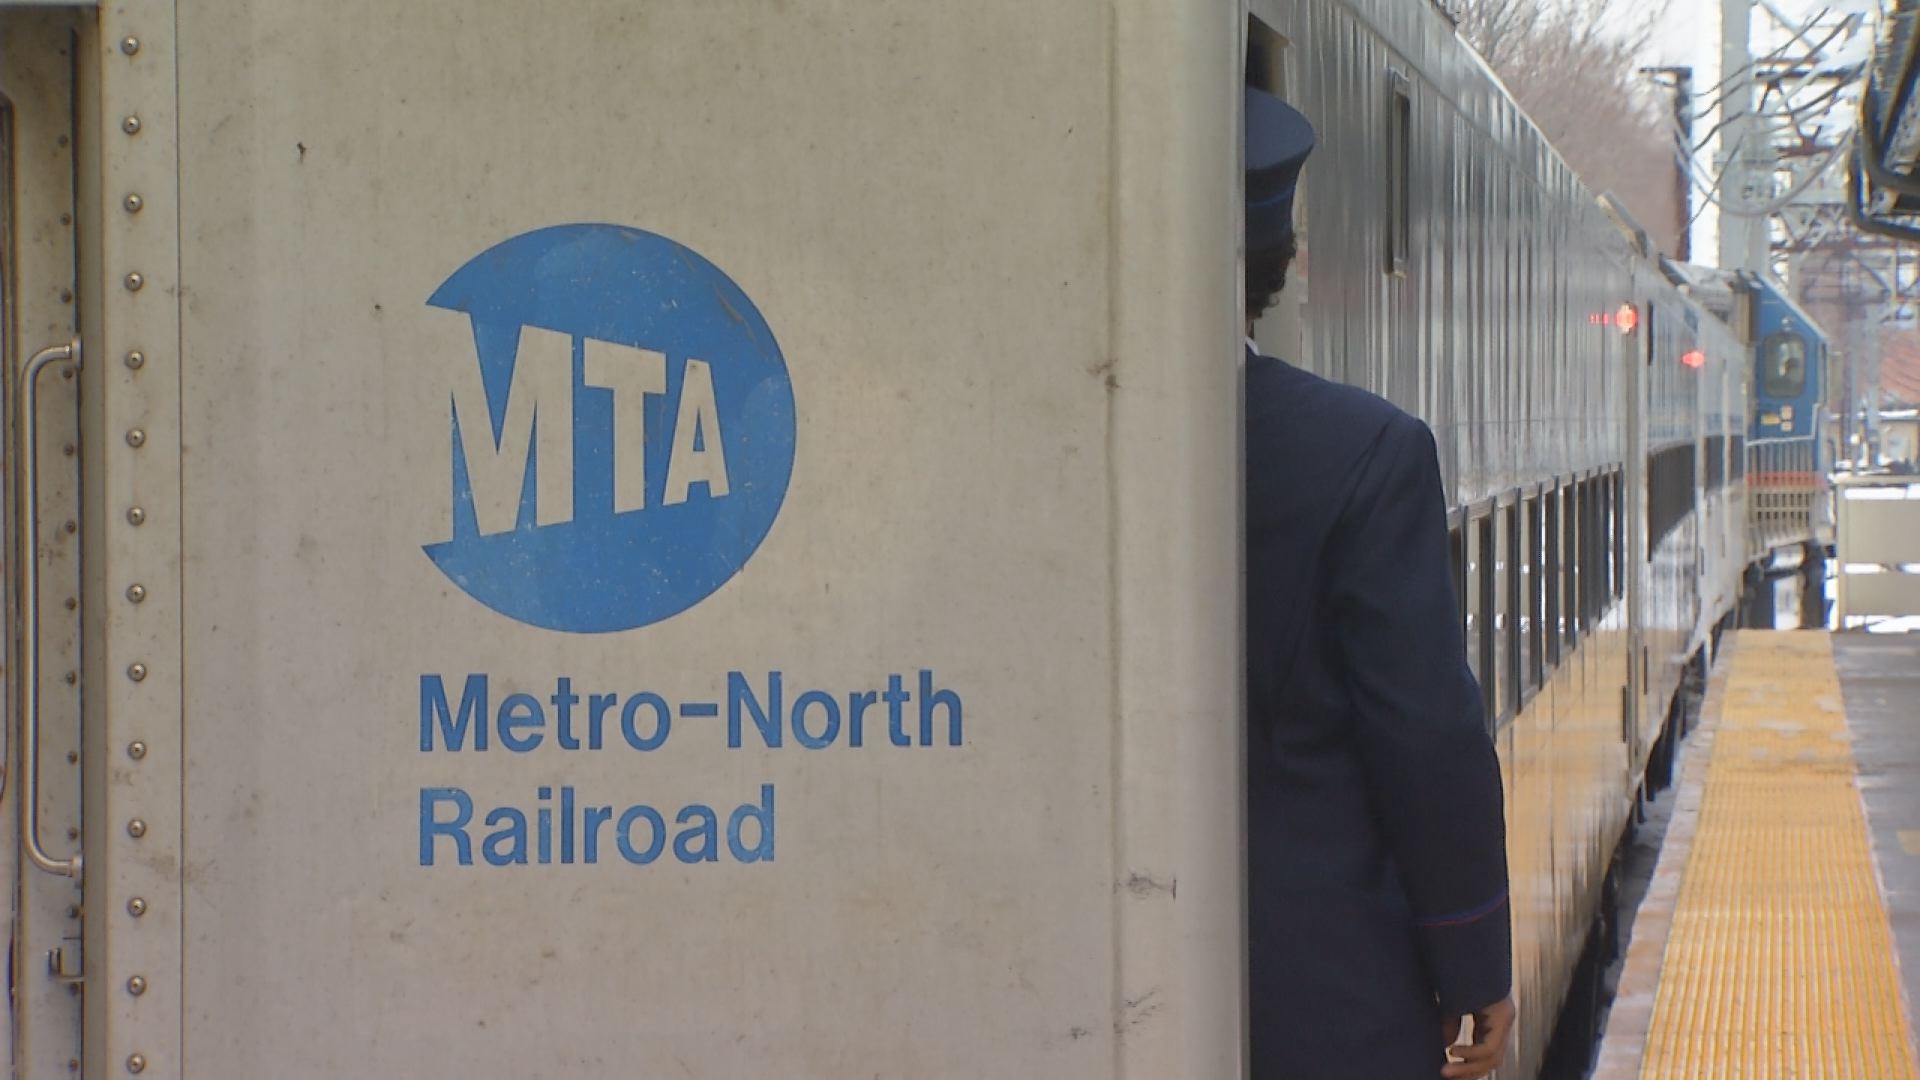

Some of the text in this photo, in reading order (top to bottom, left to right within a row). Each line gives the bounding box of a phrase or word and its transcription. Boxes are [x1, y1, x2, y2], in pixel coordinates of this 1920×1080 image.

[421, 303, 730, 548] MTA
[420, 670, 962, 752] Metro-North
[420, 783, 775, 865] Railroad
